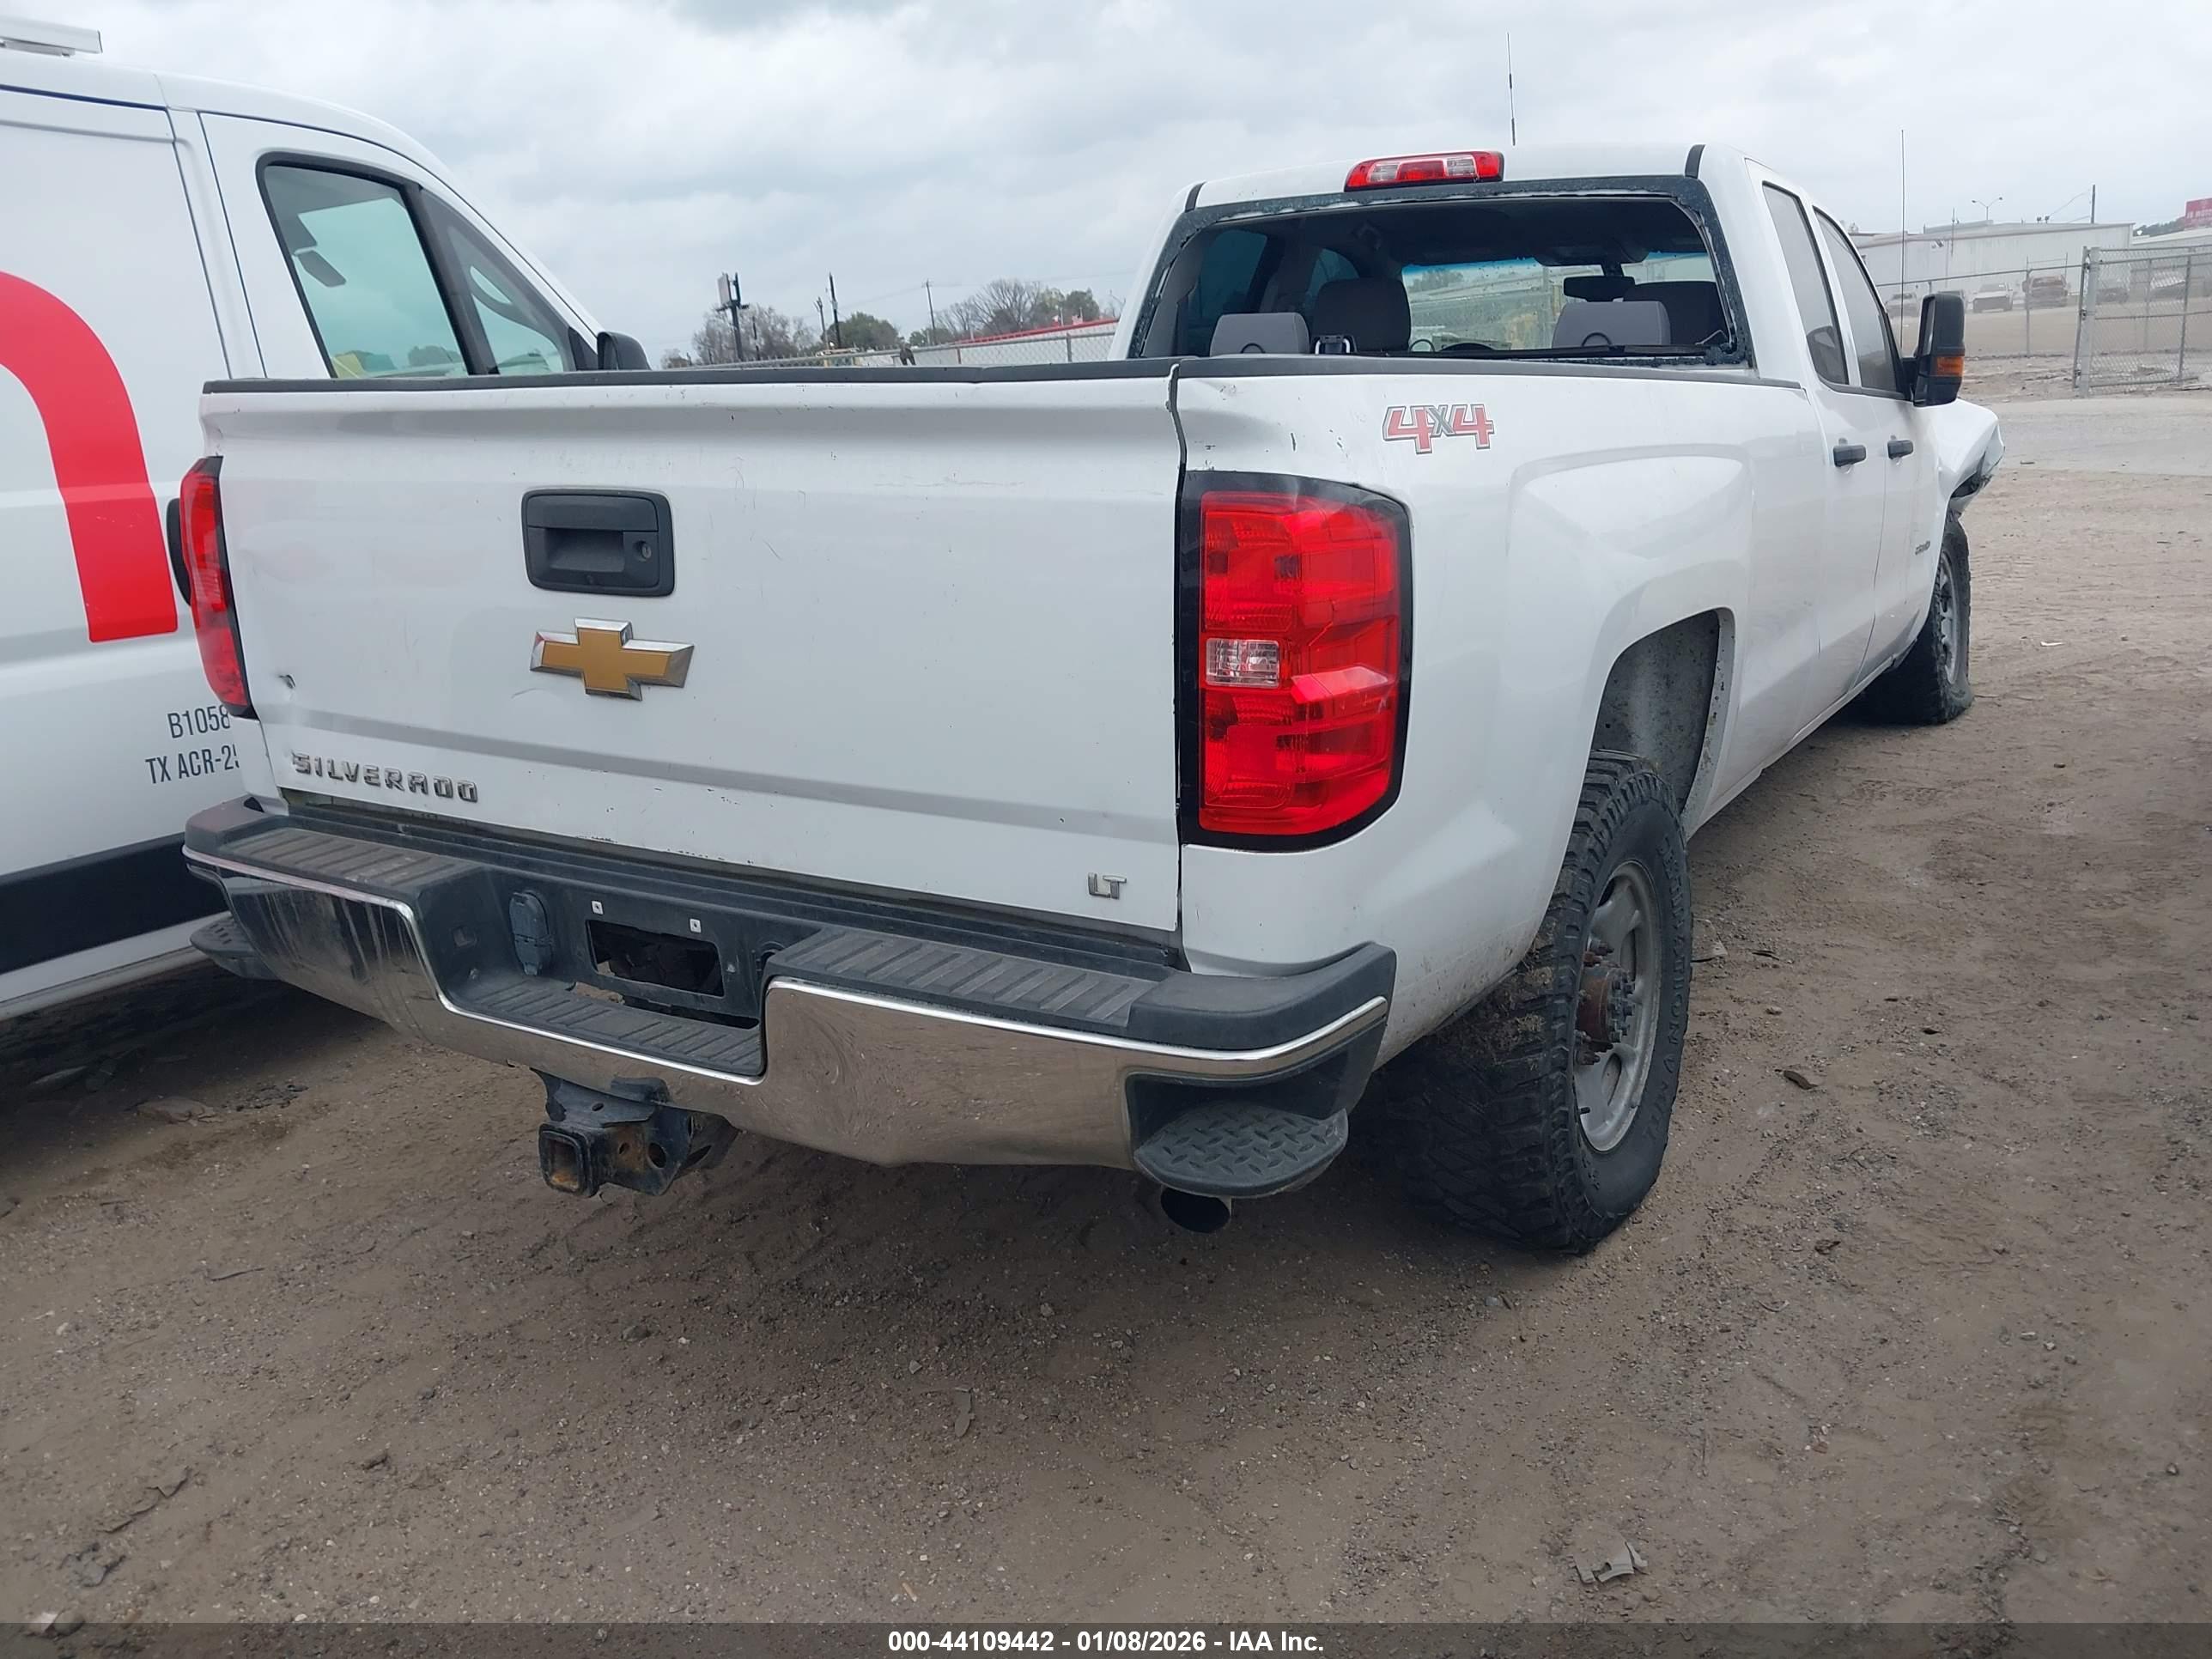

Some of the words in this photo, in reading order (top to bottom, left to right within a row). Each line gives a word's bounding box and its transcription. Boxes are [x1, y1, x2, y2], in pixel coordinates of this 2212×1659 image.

[167, 704, 231, 738] B1058
[145, 756, 172, 784] TX
[292, 751, 478, 803] SILVERADO
[1087, 872, 1127, 900] LT
